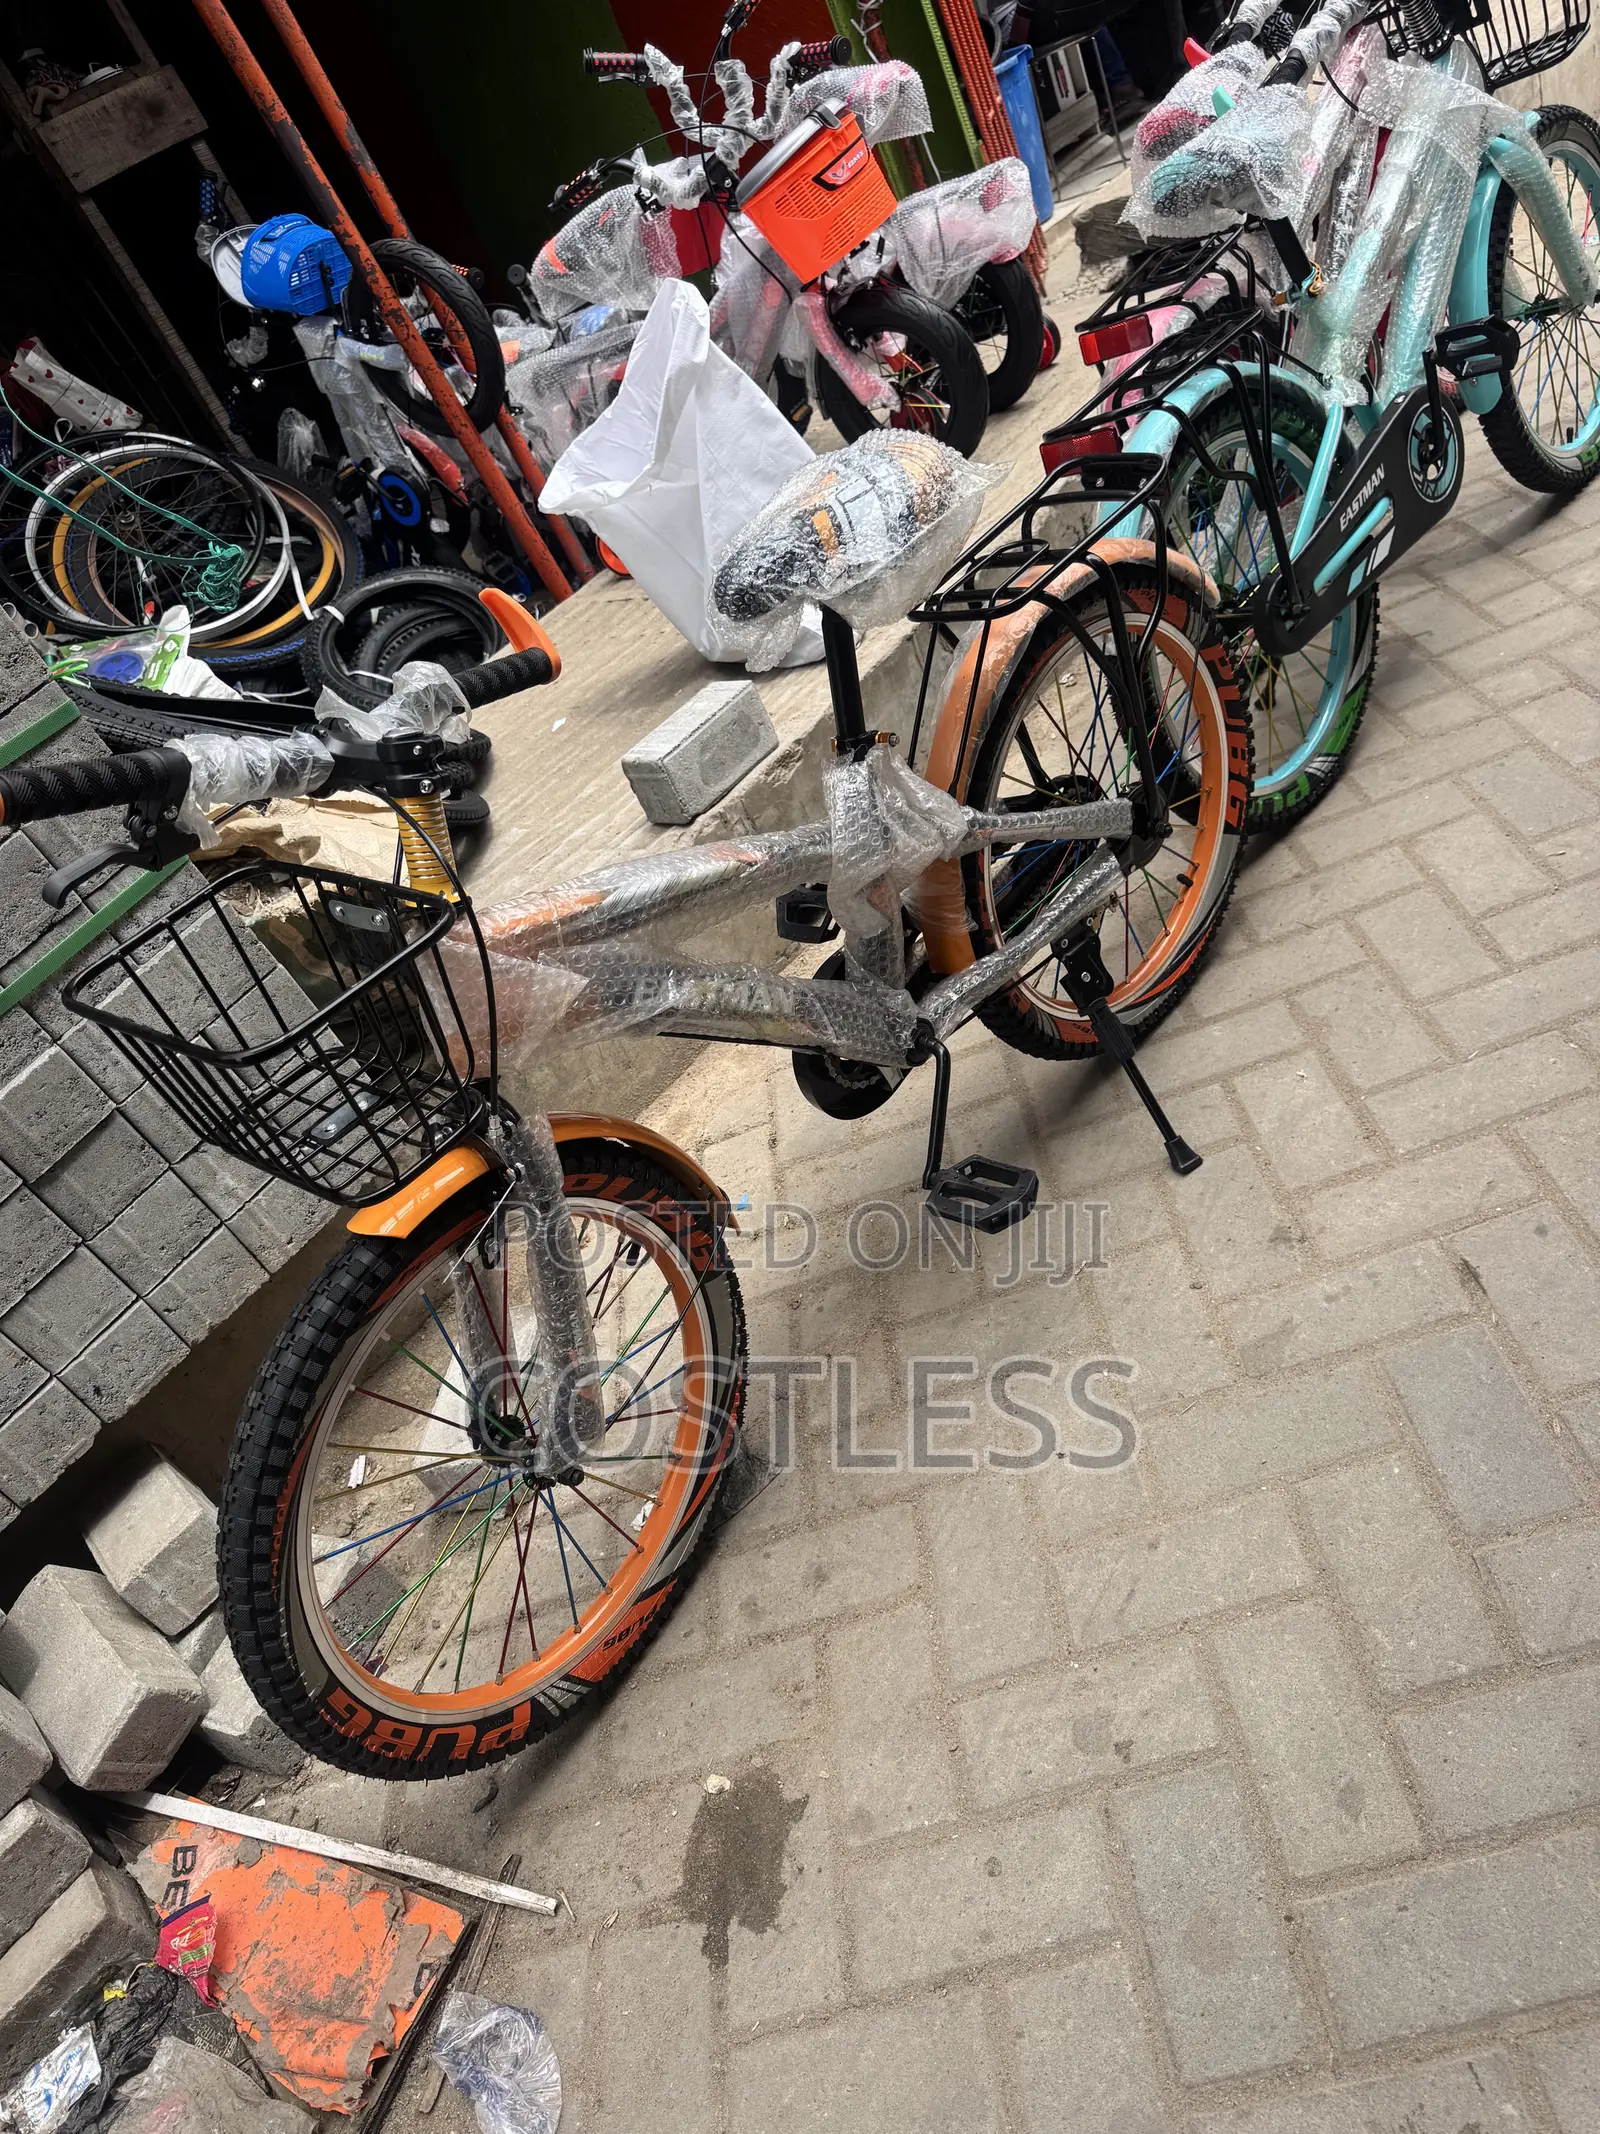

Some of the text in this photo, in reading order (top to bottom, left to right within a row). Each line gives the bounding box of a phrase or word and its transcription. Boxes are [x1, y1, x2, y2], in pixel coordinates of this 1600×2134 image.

[1339, 463, 1385, 533] EASTMAN
[602, 1609, 659, 1652] PUBG
[319, 1688, 531, 1761] PUBG
